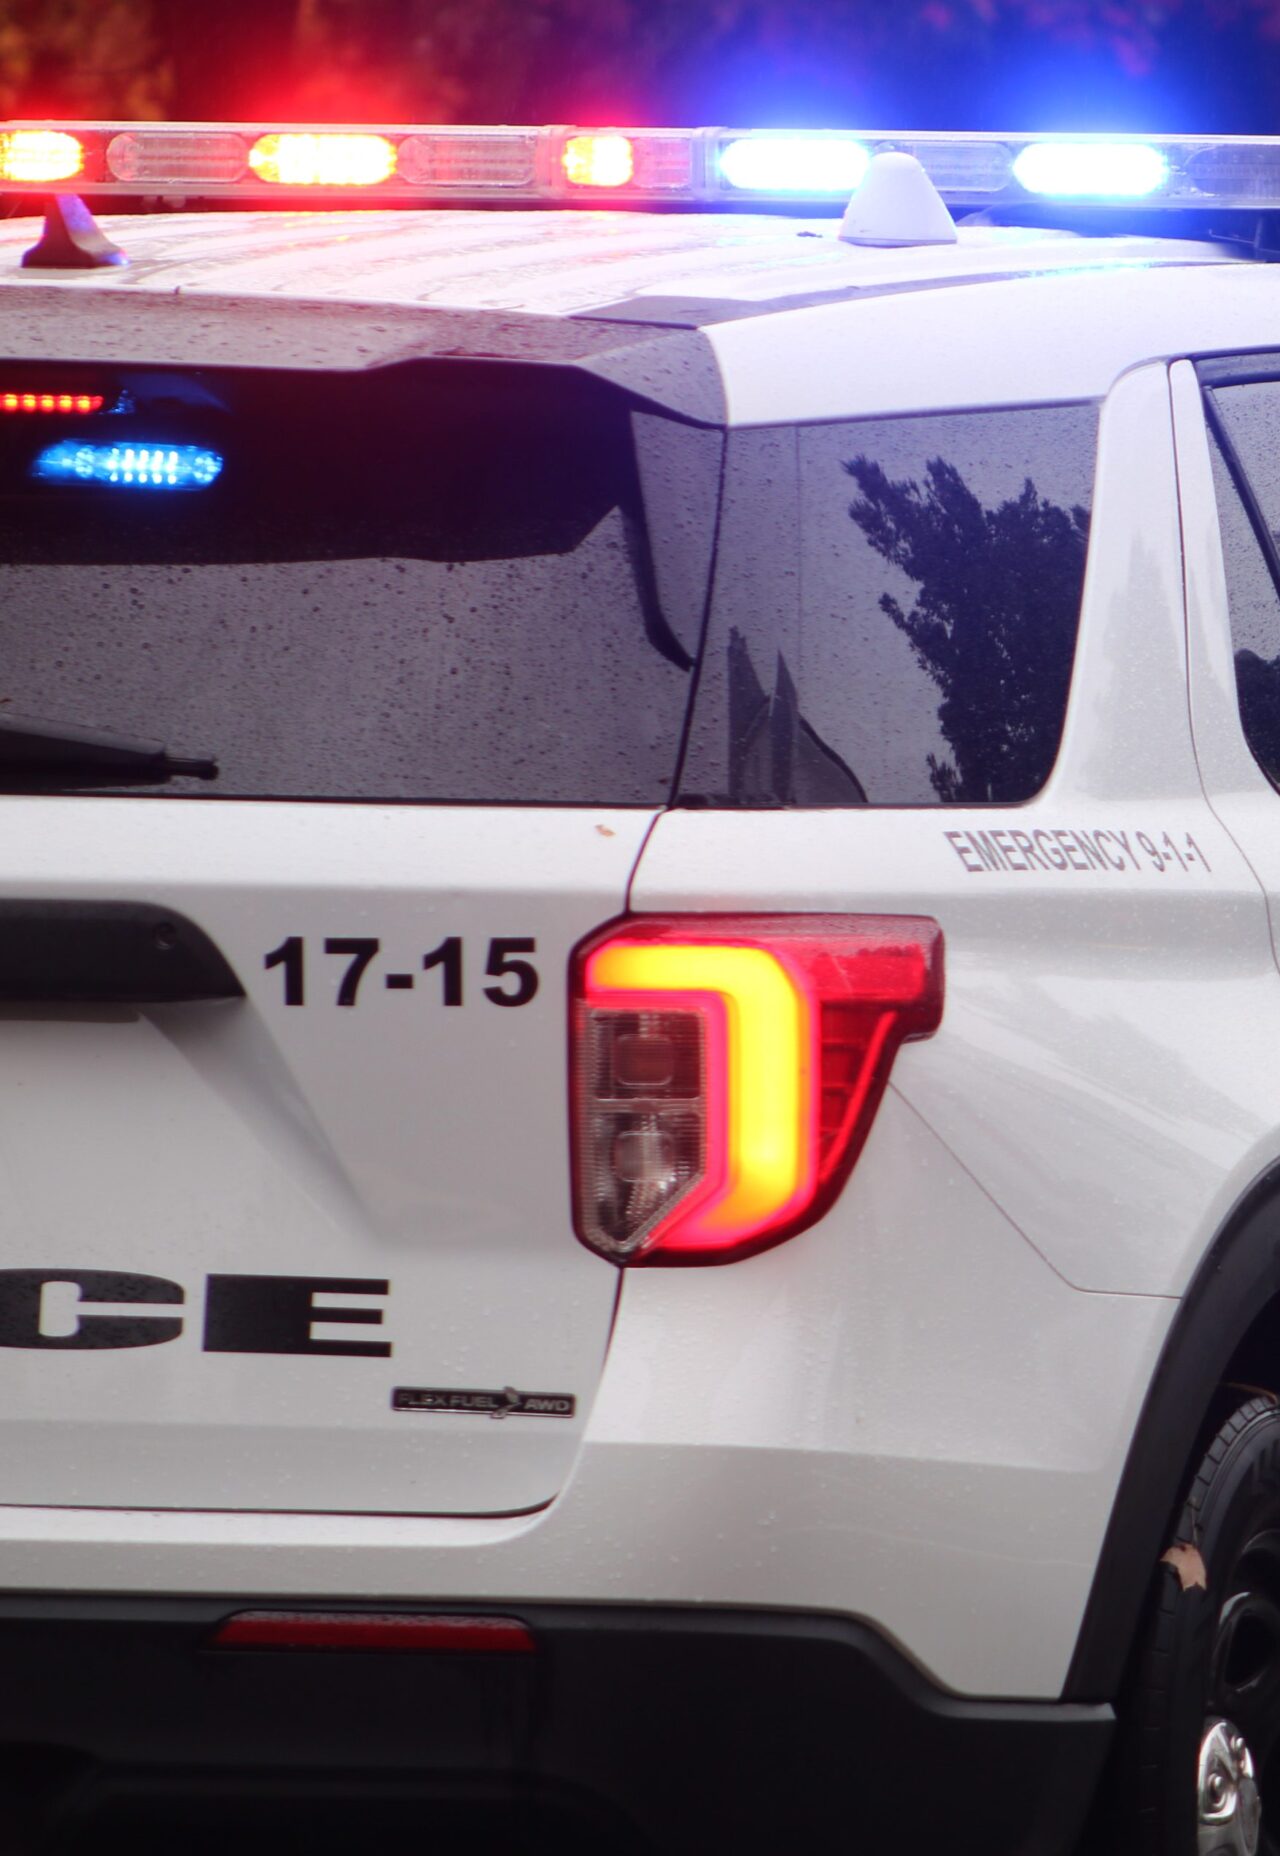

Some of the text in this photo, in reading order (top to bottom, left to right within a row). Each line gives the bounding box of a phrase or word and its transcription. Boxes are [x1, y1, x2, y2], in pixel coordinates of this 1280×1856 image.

[943, 830, 1212, 873] EMERGENCY 9-1-1
[265, 937, 538, 1007] 17-15
[450, 1395, 499, 1408] FUEL
[523, 1398, 571, 1412] AWD
